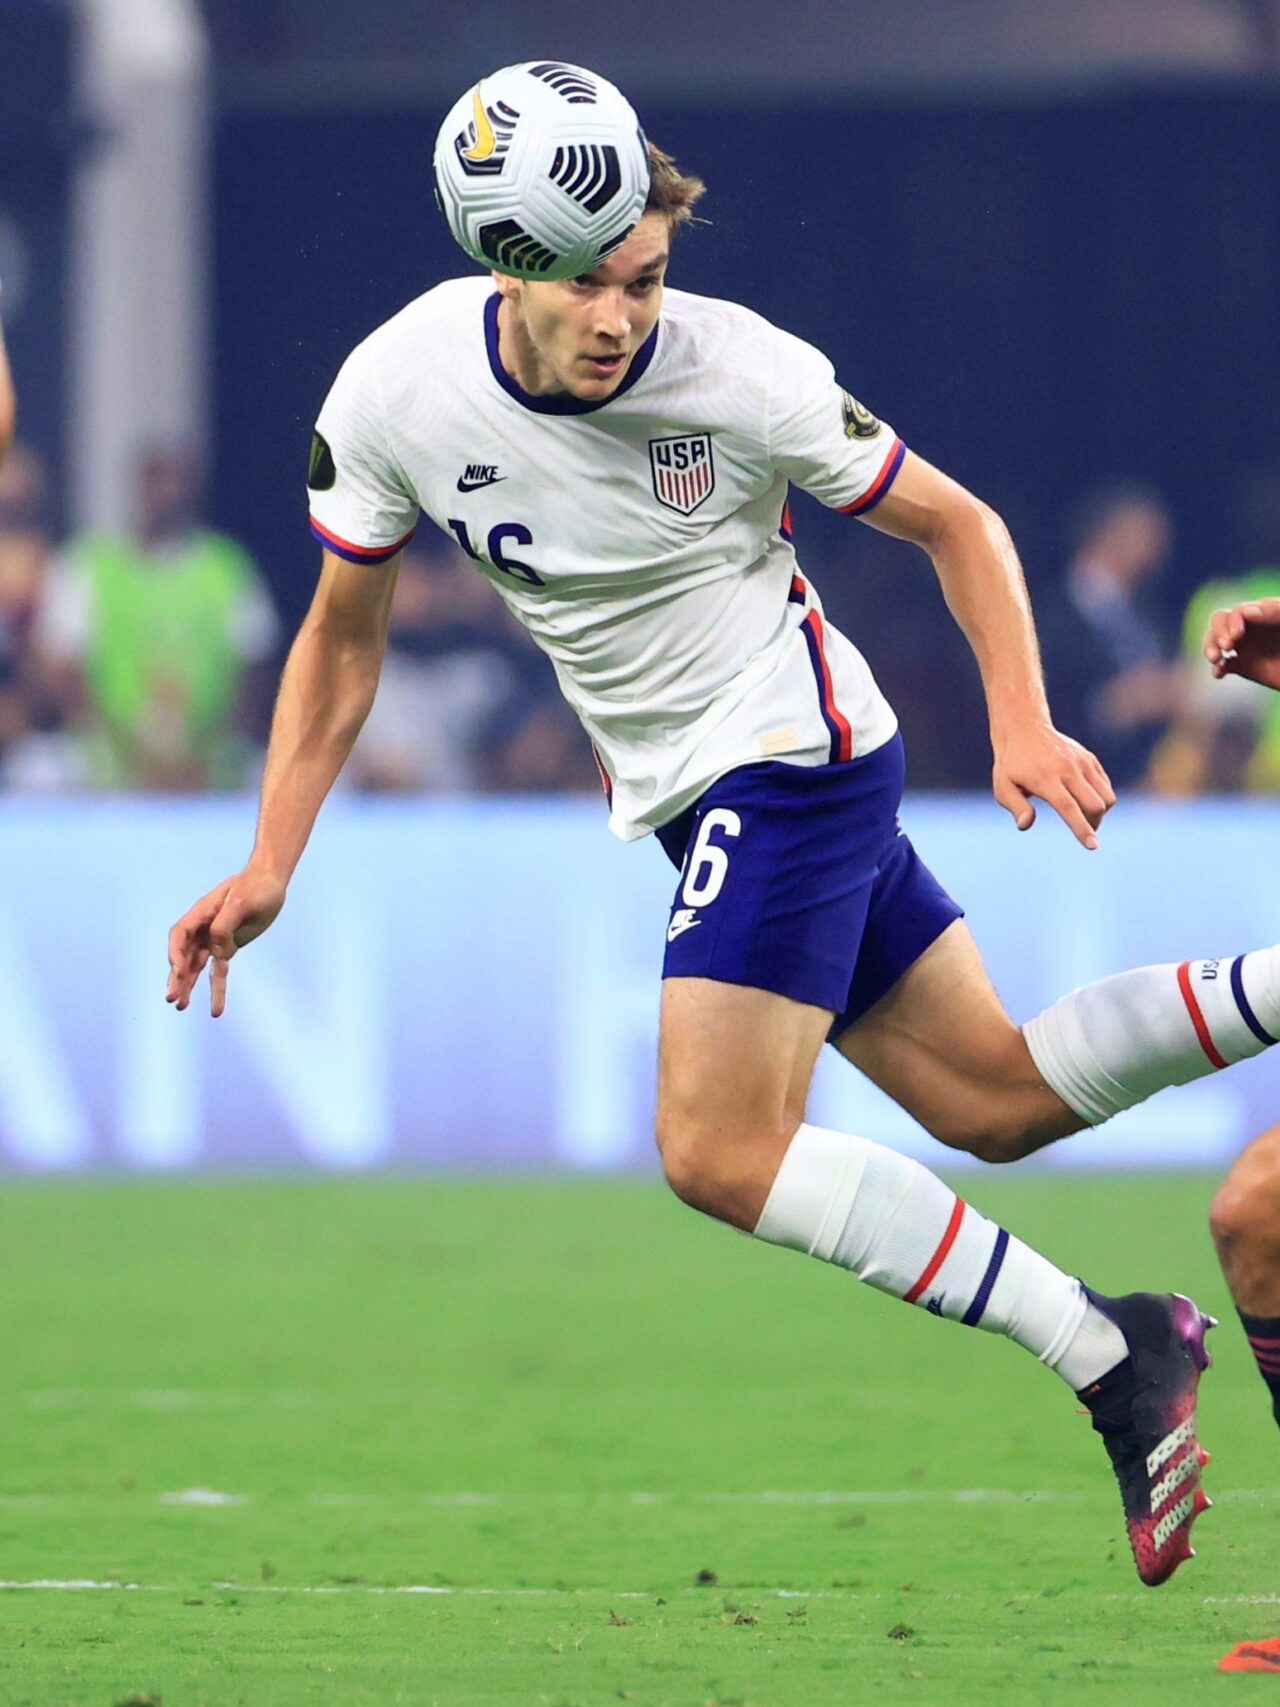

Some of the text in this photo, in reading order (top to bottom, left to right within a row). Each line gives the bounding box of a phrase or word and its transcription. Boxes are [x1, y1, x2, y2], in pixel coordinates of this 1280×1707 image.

[464, 464, 498, 481] NIKE
[656, 440, 705, 470] USA
[447, 519, 546, 586] 16
[680, 807, 742, 908] 6
